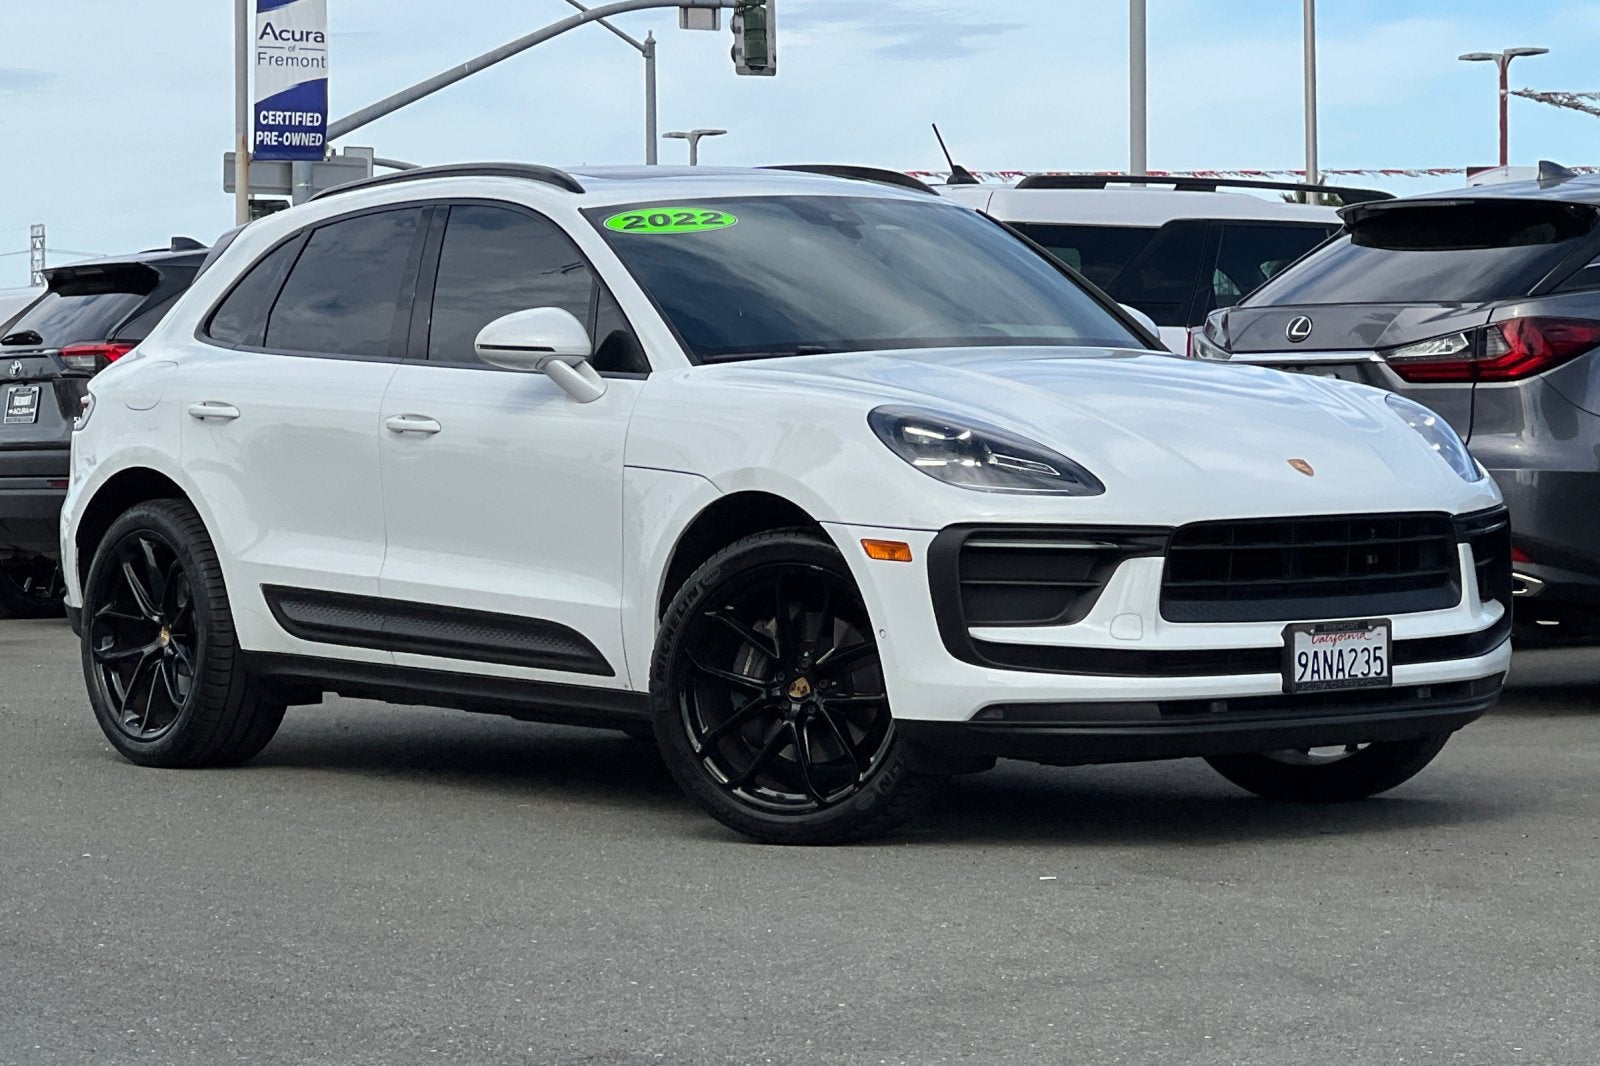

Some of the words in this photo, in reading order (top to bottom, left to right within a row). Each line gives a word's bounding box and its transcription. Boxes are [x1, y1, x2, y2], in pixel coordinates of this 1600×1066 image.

[258, 22, 325, 43] Acura
[257, 52, 326, 69] Fremont
[259, 111, 322, 126] CERTIFIED
[256, 131, 323, 146] PRE-OWNED
[622, 212, 725, 229] 2022
[655, 584, 701, 683] MICHELIN
[1297, 646, 1384, 682] 9ANA235
